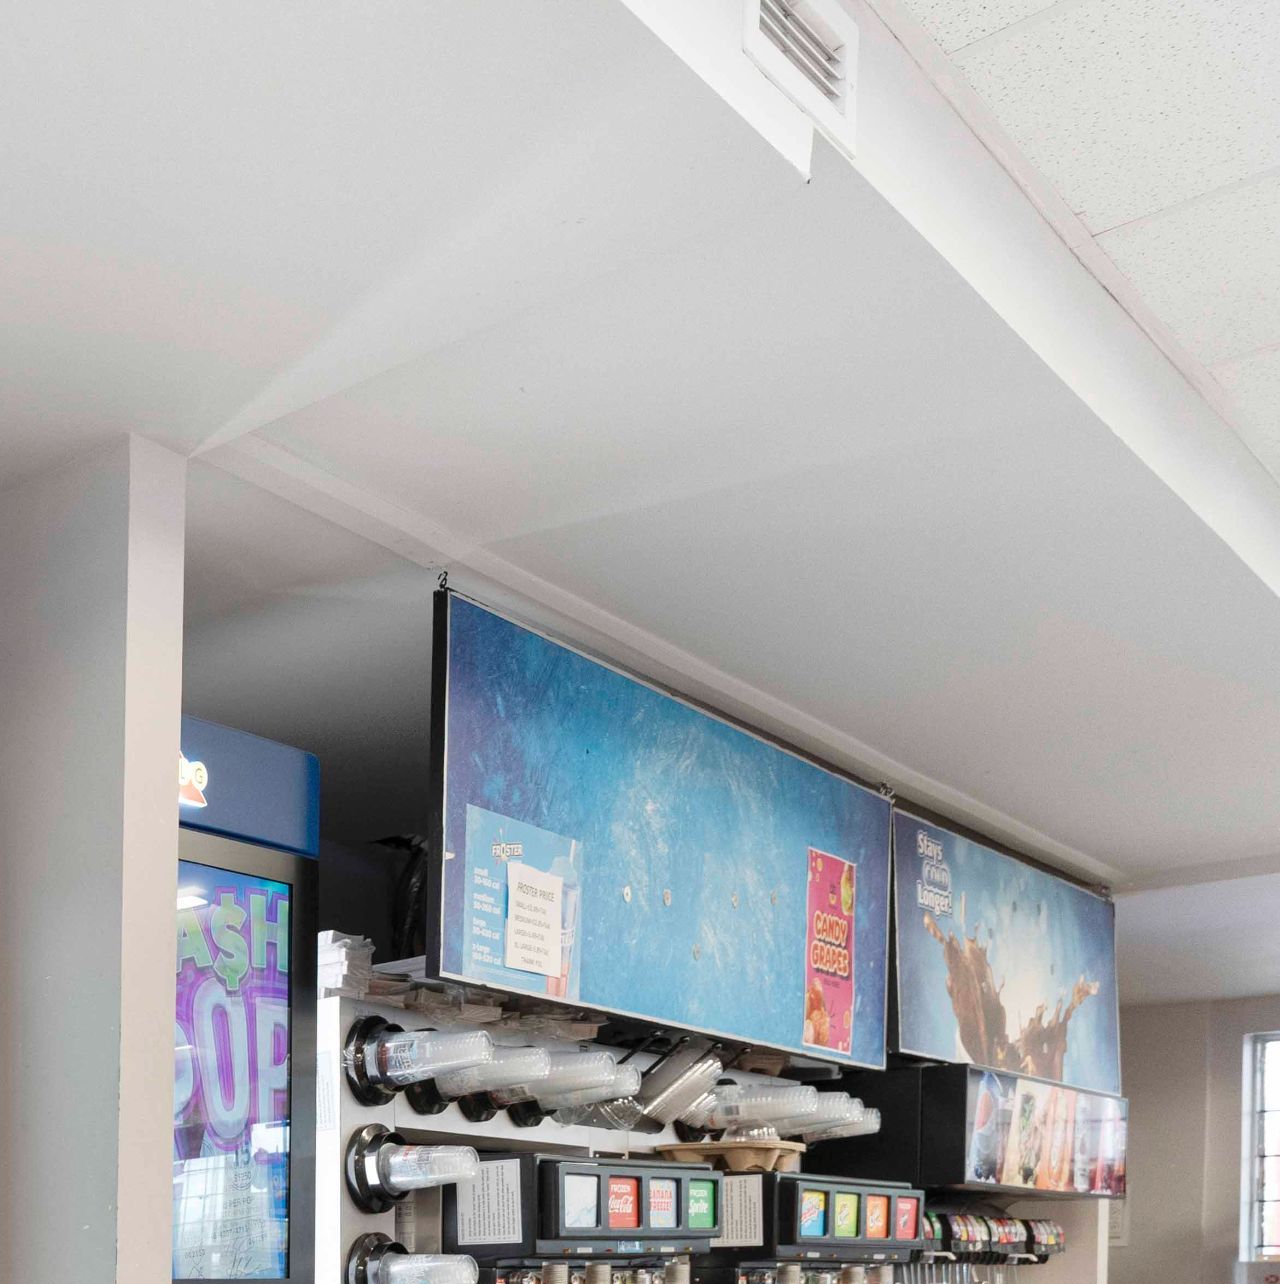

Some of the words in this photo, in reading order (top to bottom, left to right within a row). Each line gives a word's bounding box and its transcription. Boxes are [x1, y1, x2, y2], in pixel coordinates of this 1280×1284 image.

[492, 843, 523, 858] FROSTER
[917, 830, 943, 864] Stays
[917, 880, 953, 917] Longer!
[176, 893, 289, 992] A$H
[814, 911, 849, 947] CANDY
[810, 941, 850, 977] GRAPES
